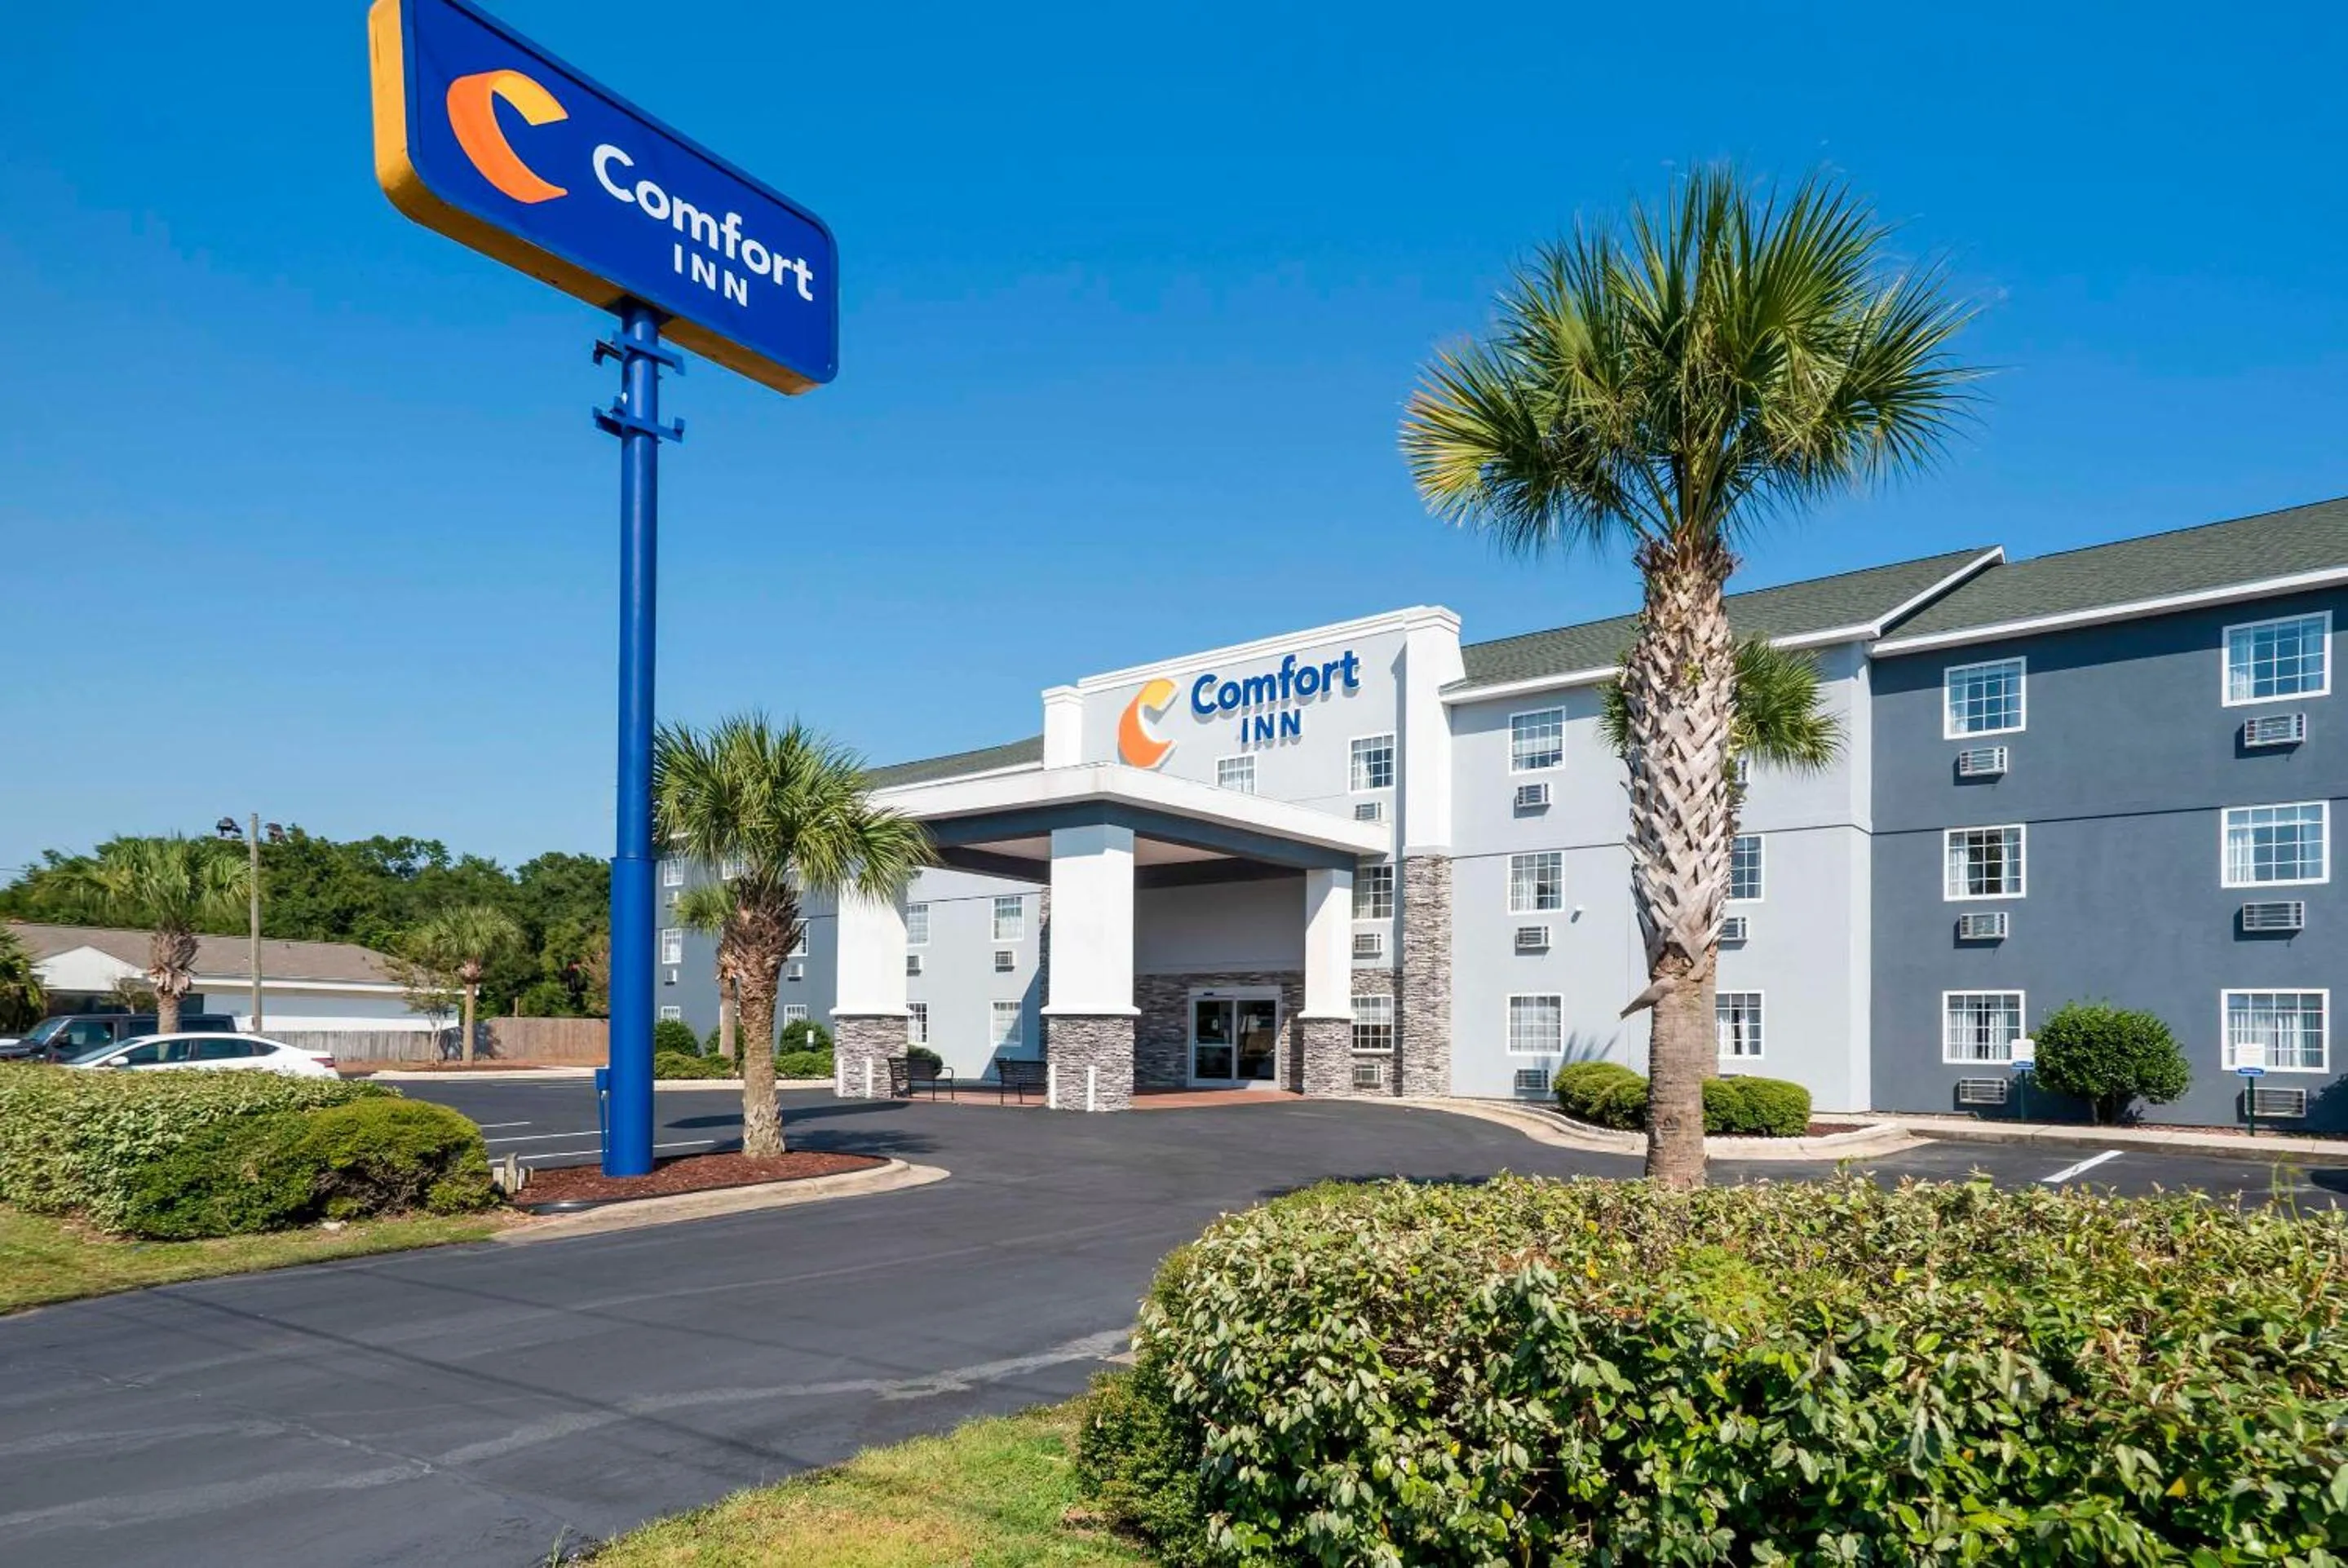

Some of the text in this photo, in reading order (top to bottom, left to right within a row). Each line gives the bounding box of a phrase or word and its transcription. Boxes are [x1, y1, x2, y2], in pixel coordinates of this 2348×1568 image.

[593, 144, 813, 302] Comfort
[674, 244, 747, 307] INN
[1191, 650, 1360, 715] Comfort
[1241, 709, 1301, 744] INN
